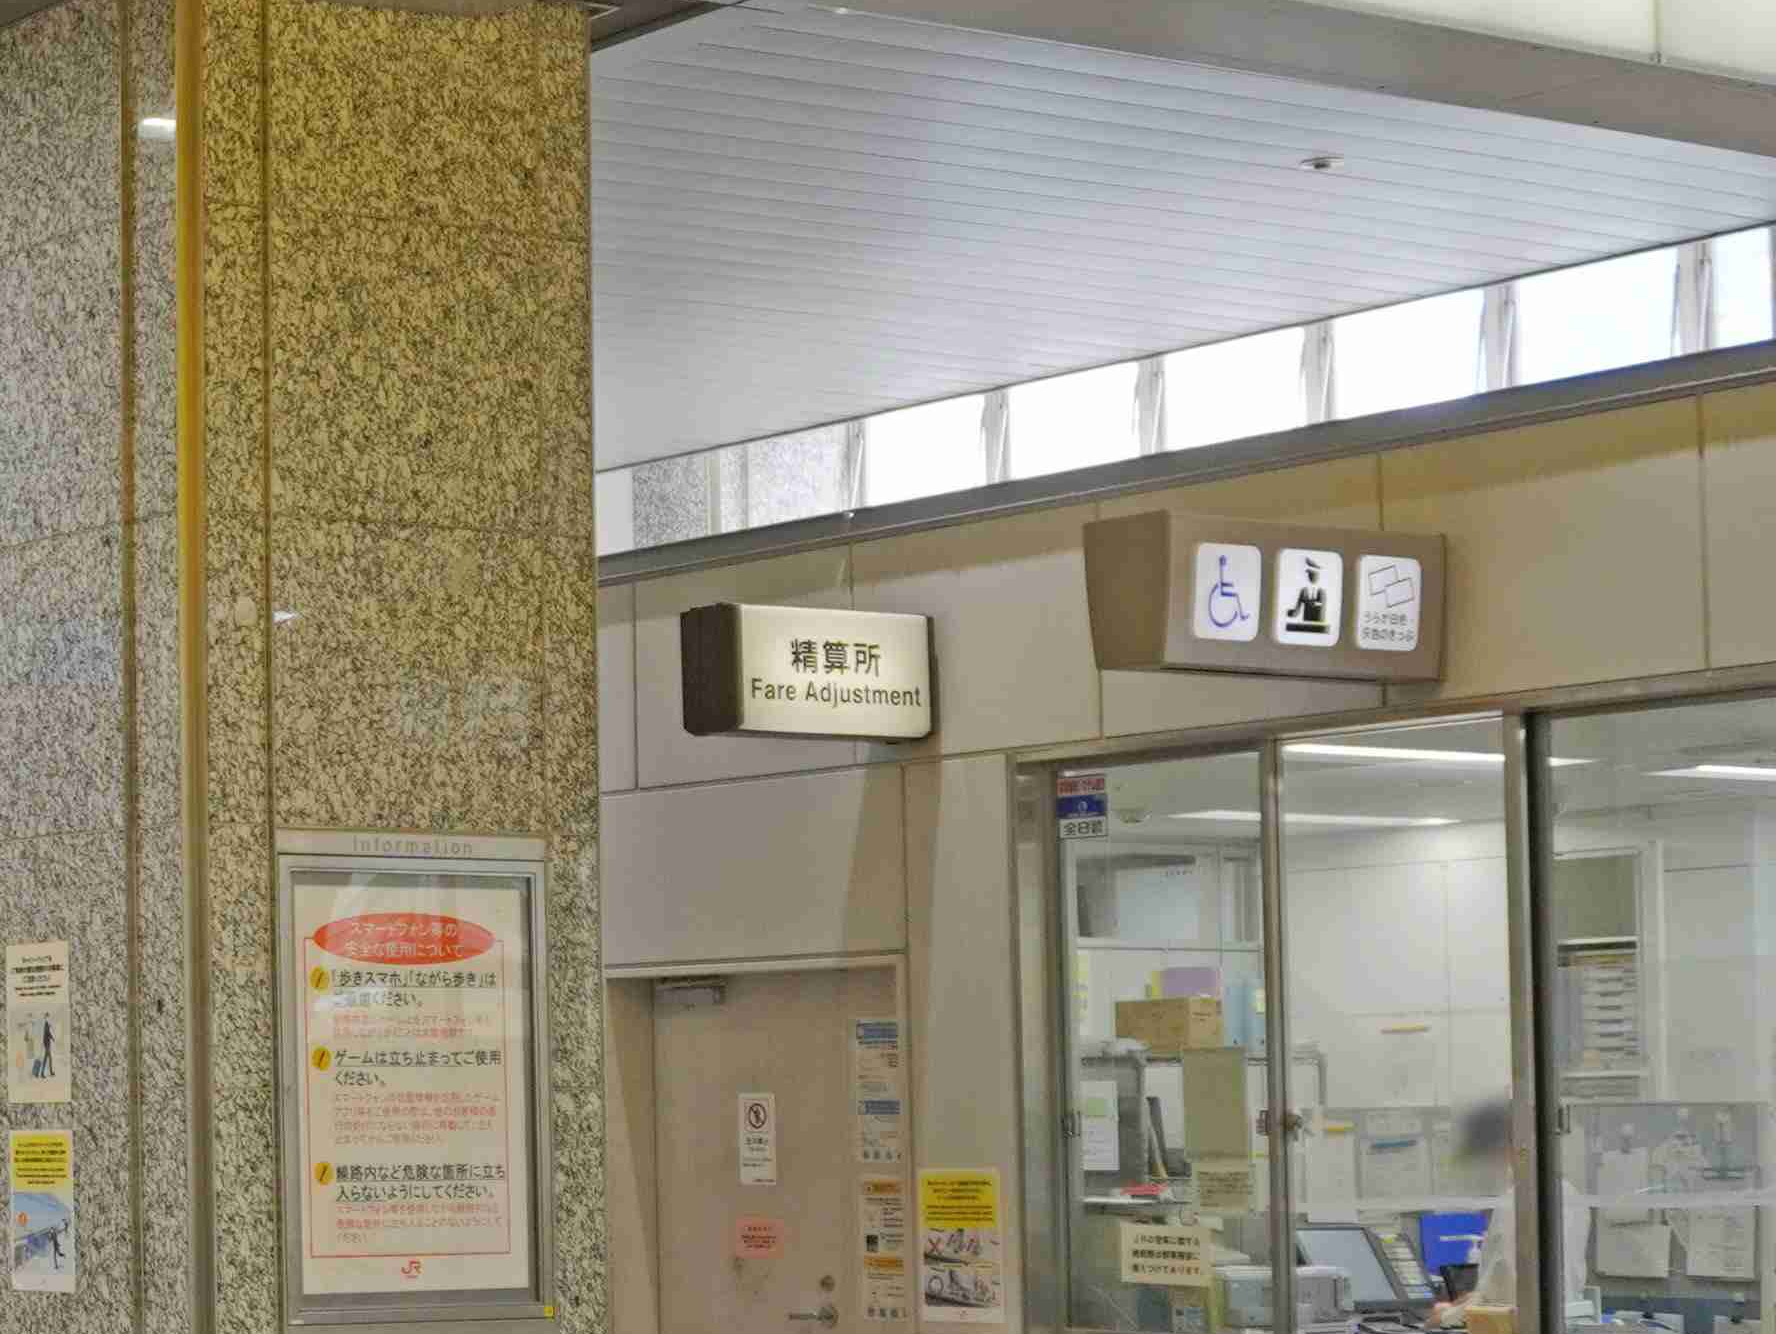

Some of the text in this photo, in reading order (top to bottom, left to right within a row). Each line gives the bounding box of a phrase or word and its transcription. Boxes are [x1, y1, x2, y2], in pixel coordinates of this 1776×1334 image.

[790, 638, 881, 677] 精算所
[751, 677, 922, 709] Fare Adjustment
[353, 835, 473, 855] Information
[401, 1260, 422, 1275] JR
